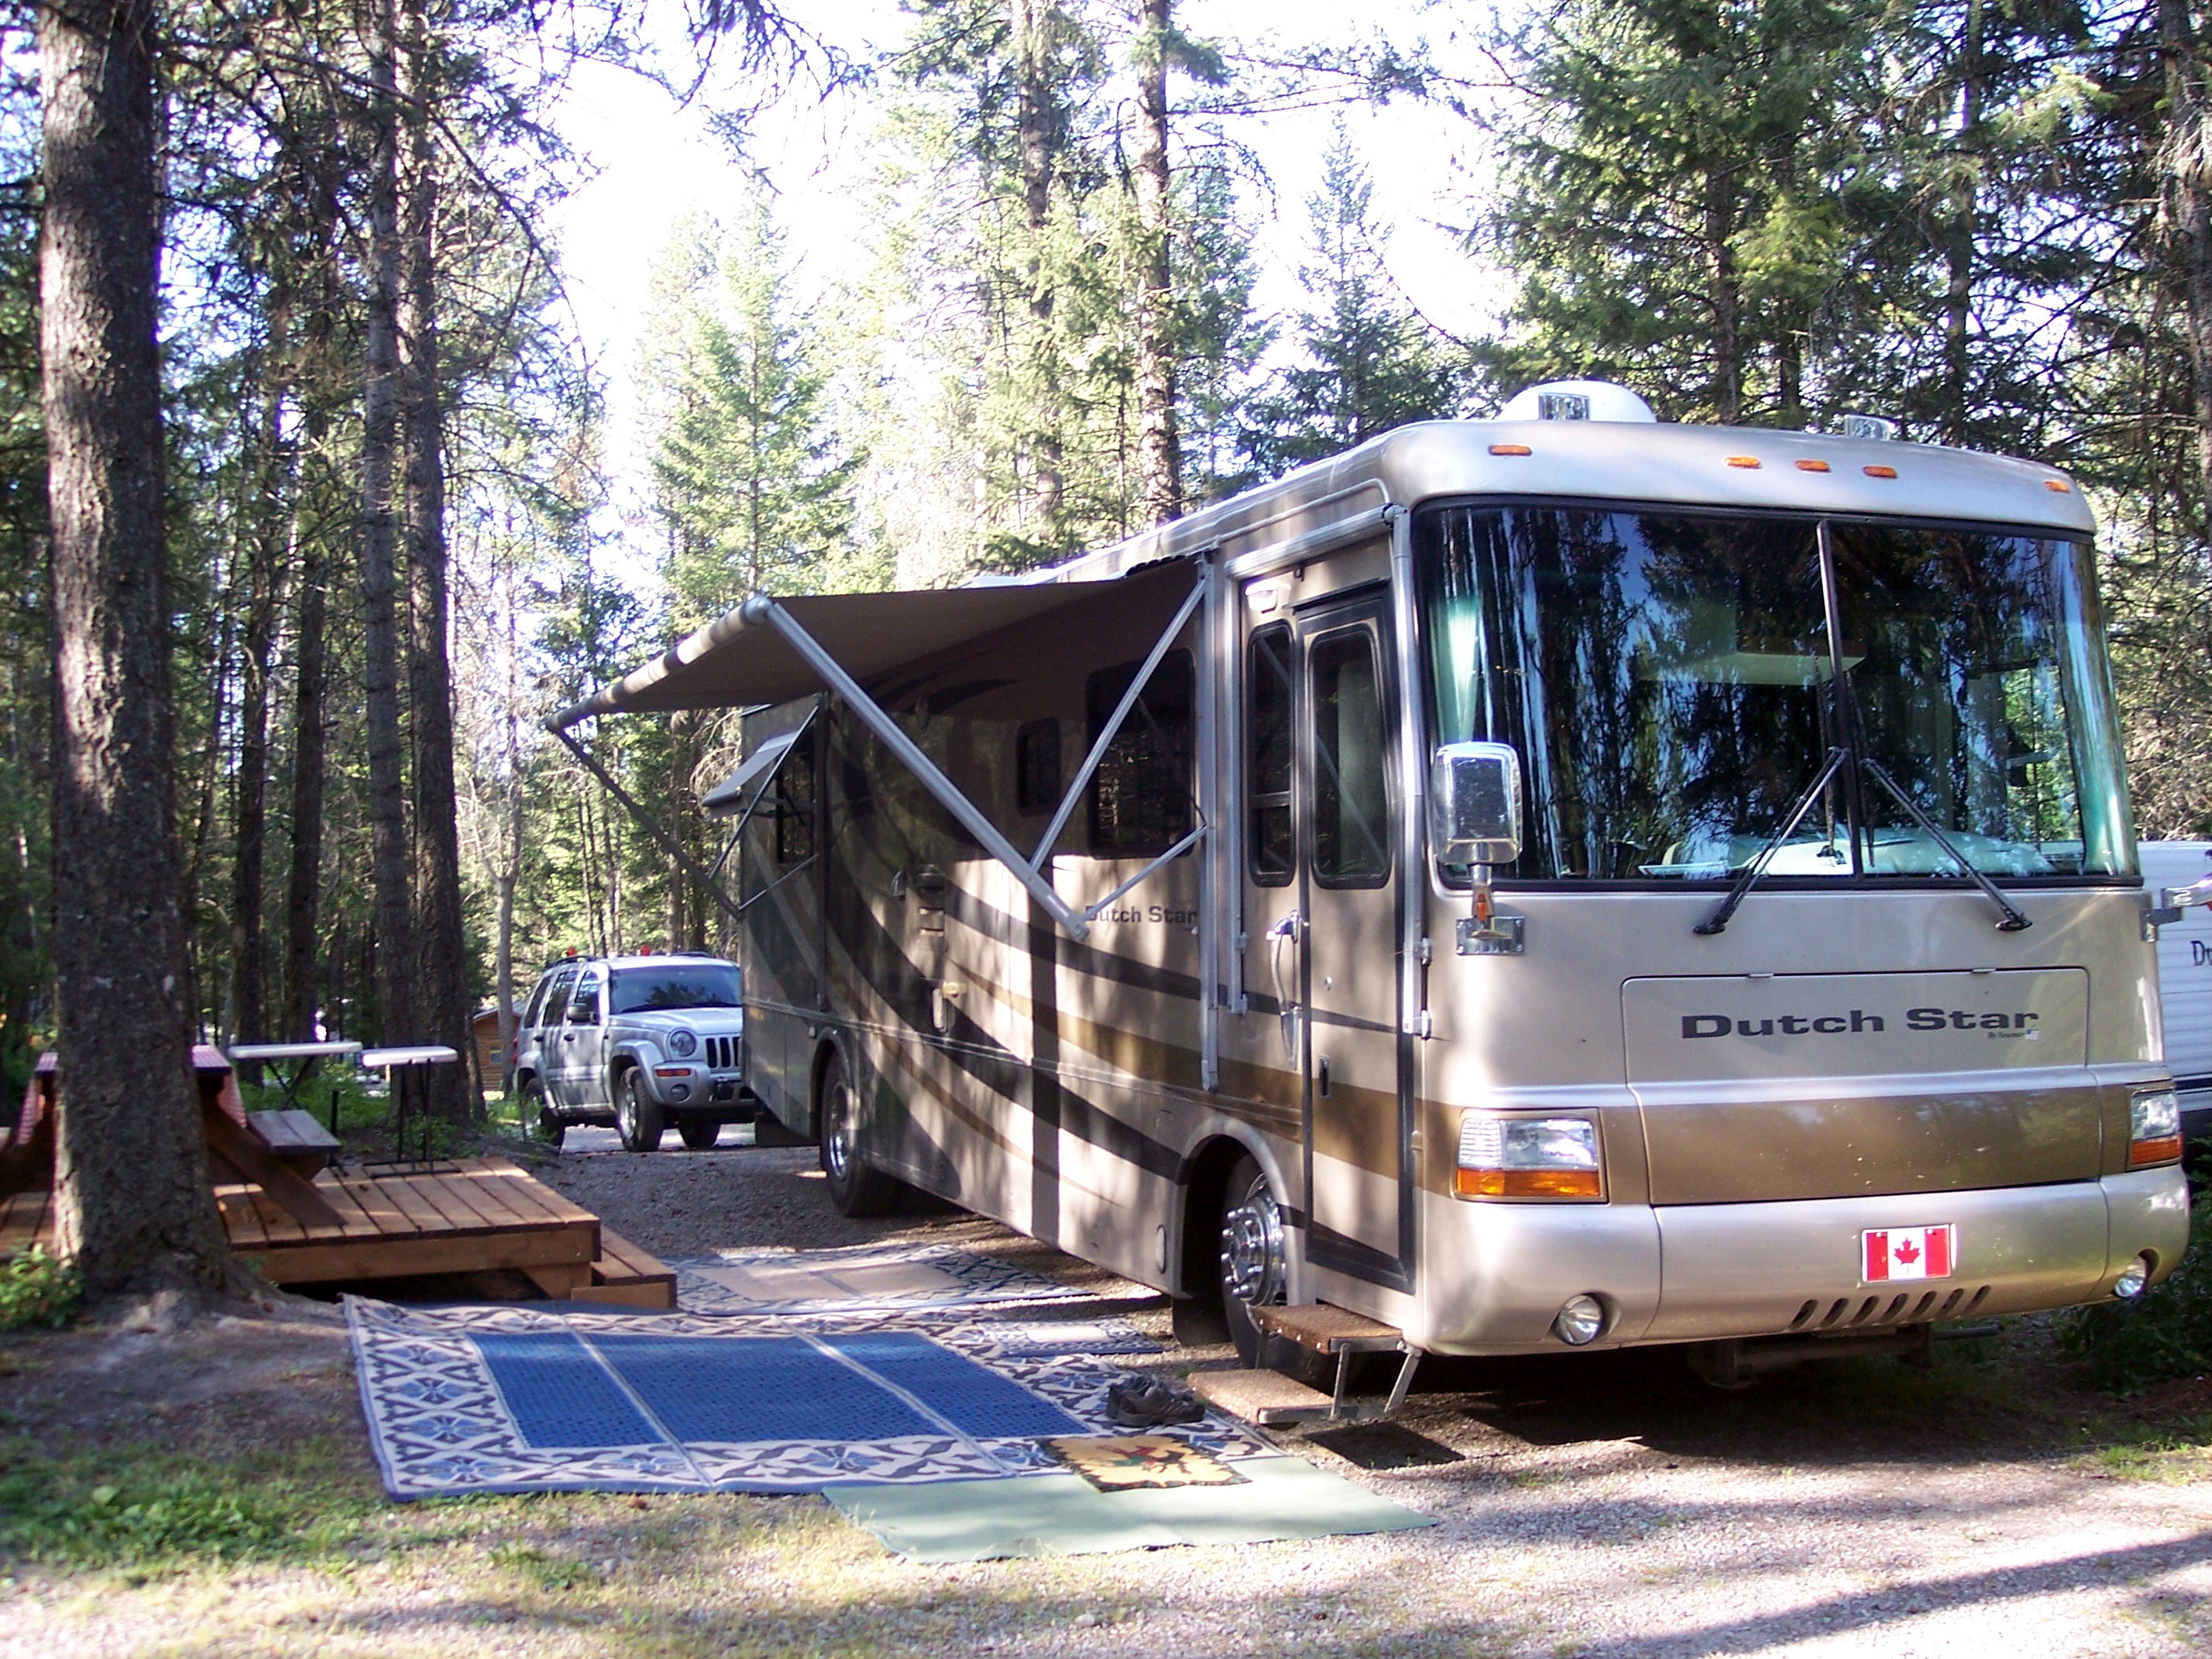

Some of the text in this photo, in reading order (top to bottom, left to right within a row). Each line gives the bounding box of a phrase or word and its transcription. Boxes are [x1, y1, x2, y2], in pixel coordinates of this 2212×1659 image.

[1149, 905, 1198, 924] Star
[1681, 1008, 2039, 1039] Dutch Star
